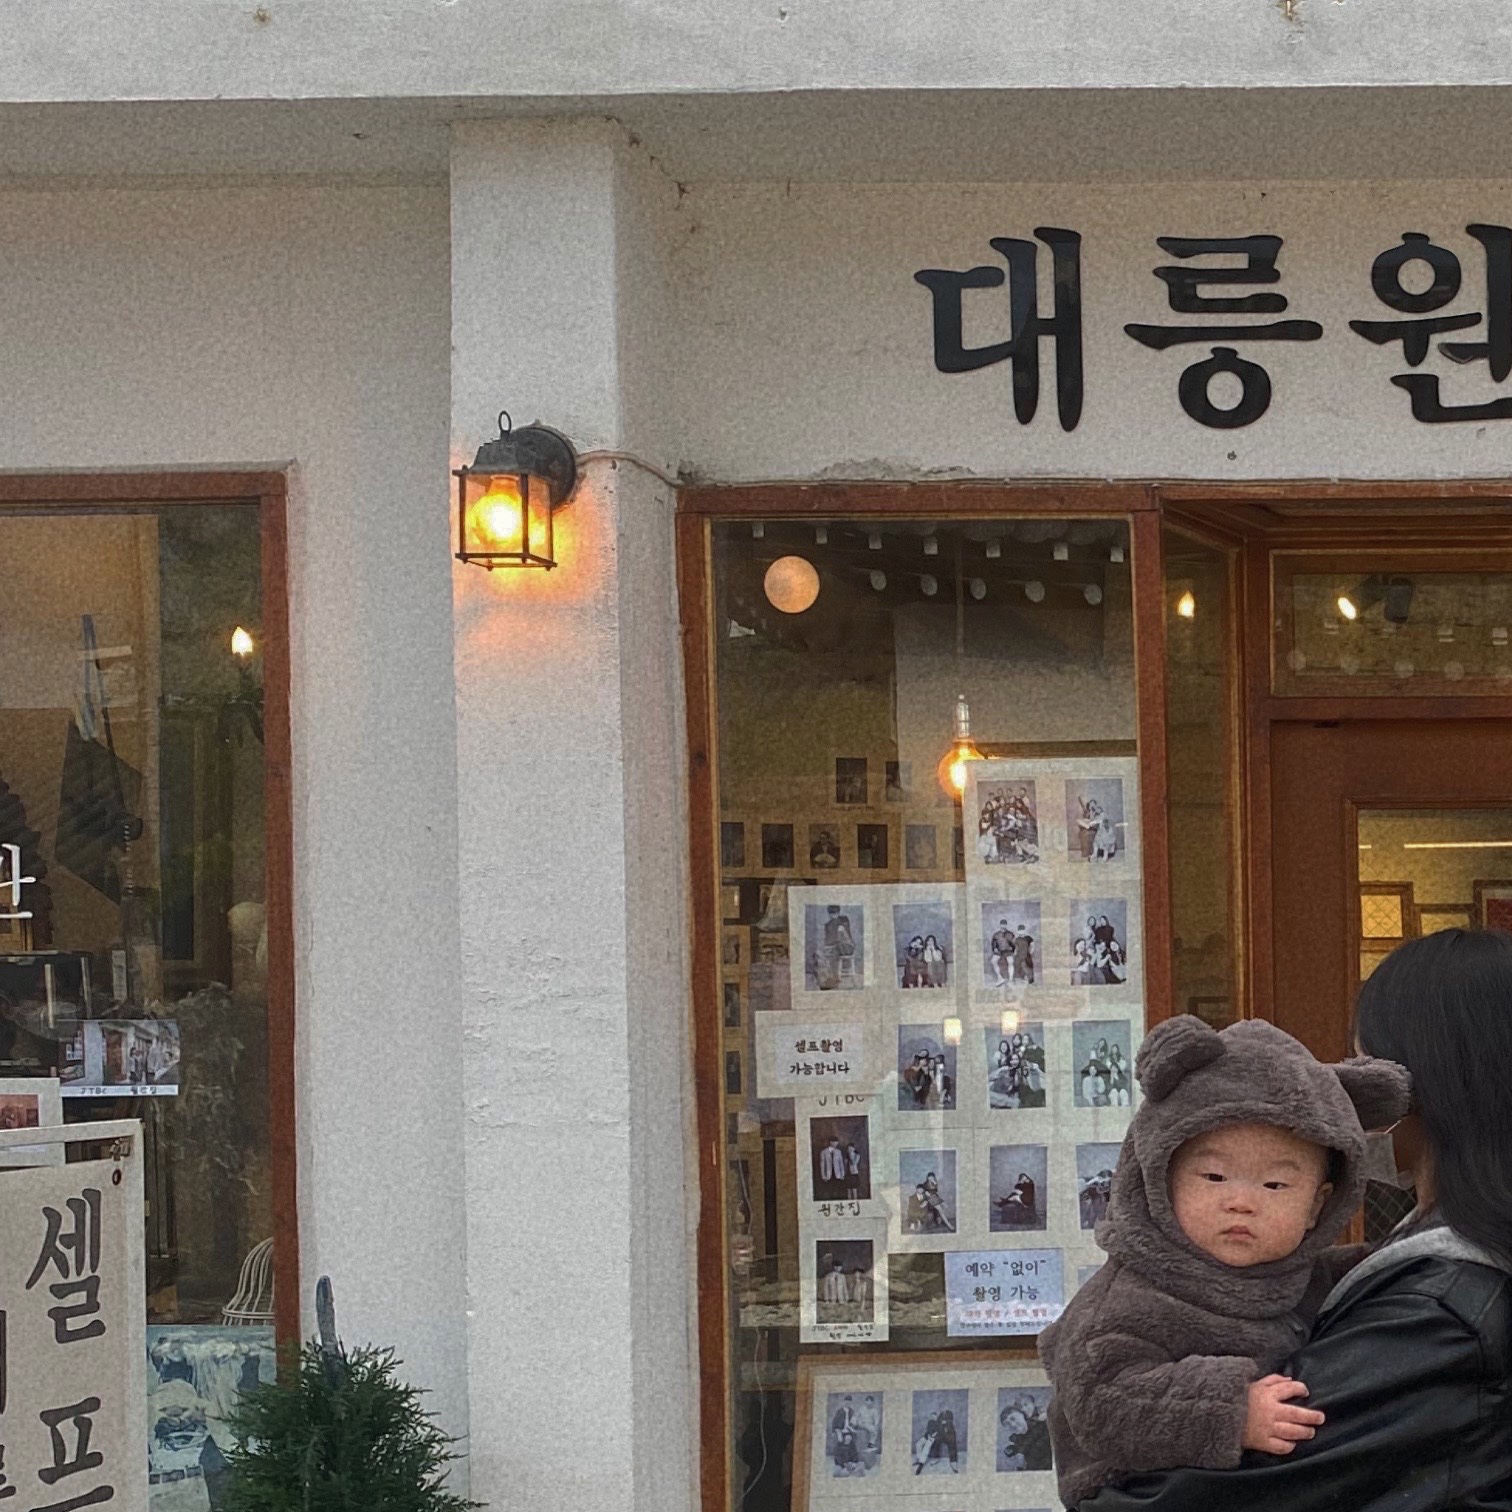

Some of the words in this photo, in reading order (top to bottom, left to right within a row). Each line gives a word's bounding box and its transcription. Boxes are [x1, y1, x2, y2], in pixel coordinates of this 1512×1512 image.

[795, 1038, 843, 1053] 셀프촬영
[789, 1061, 850, 1075] 가능합니다
[965, 1261, 994, 1277] 예약
[1010, 1284, 1040, 1301] 가능
